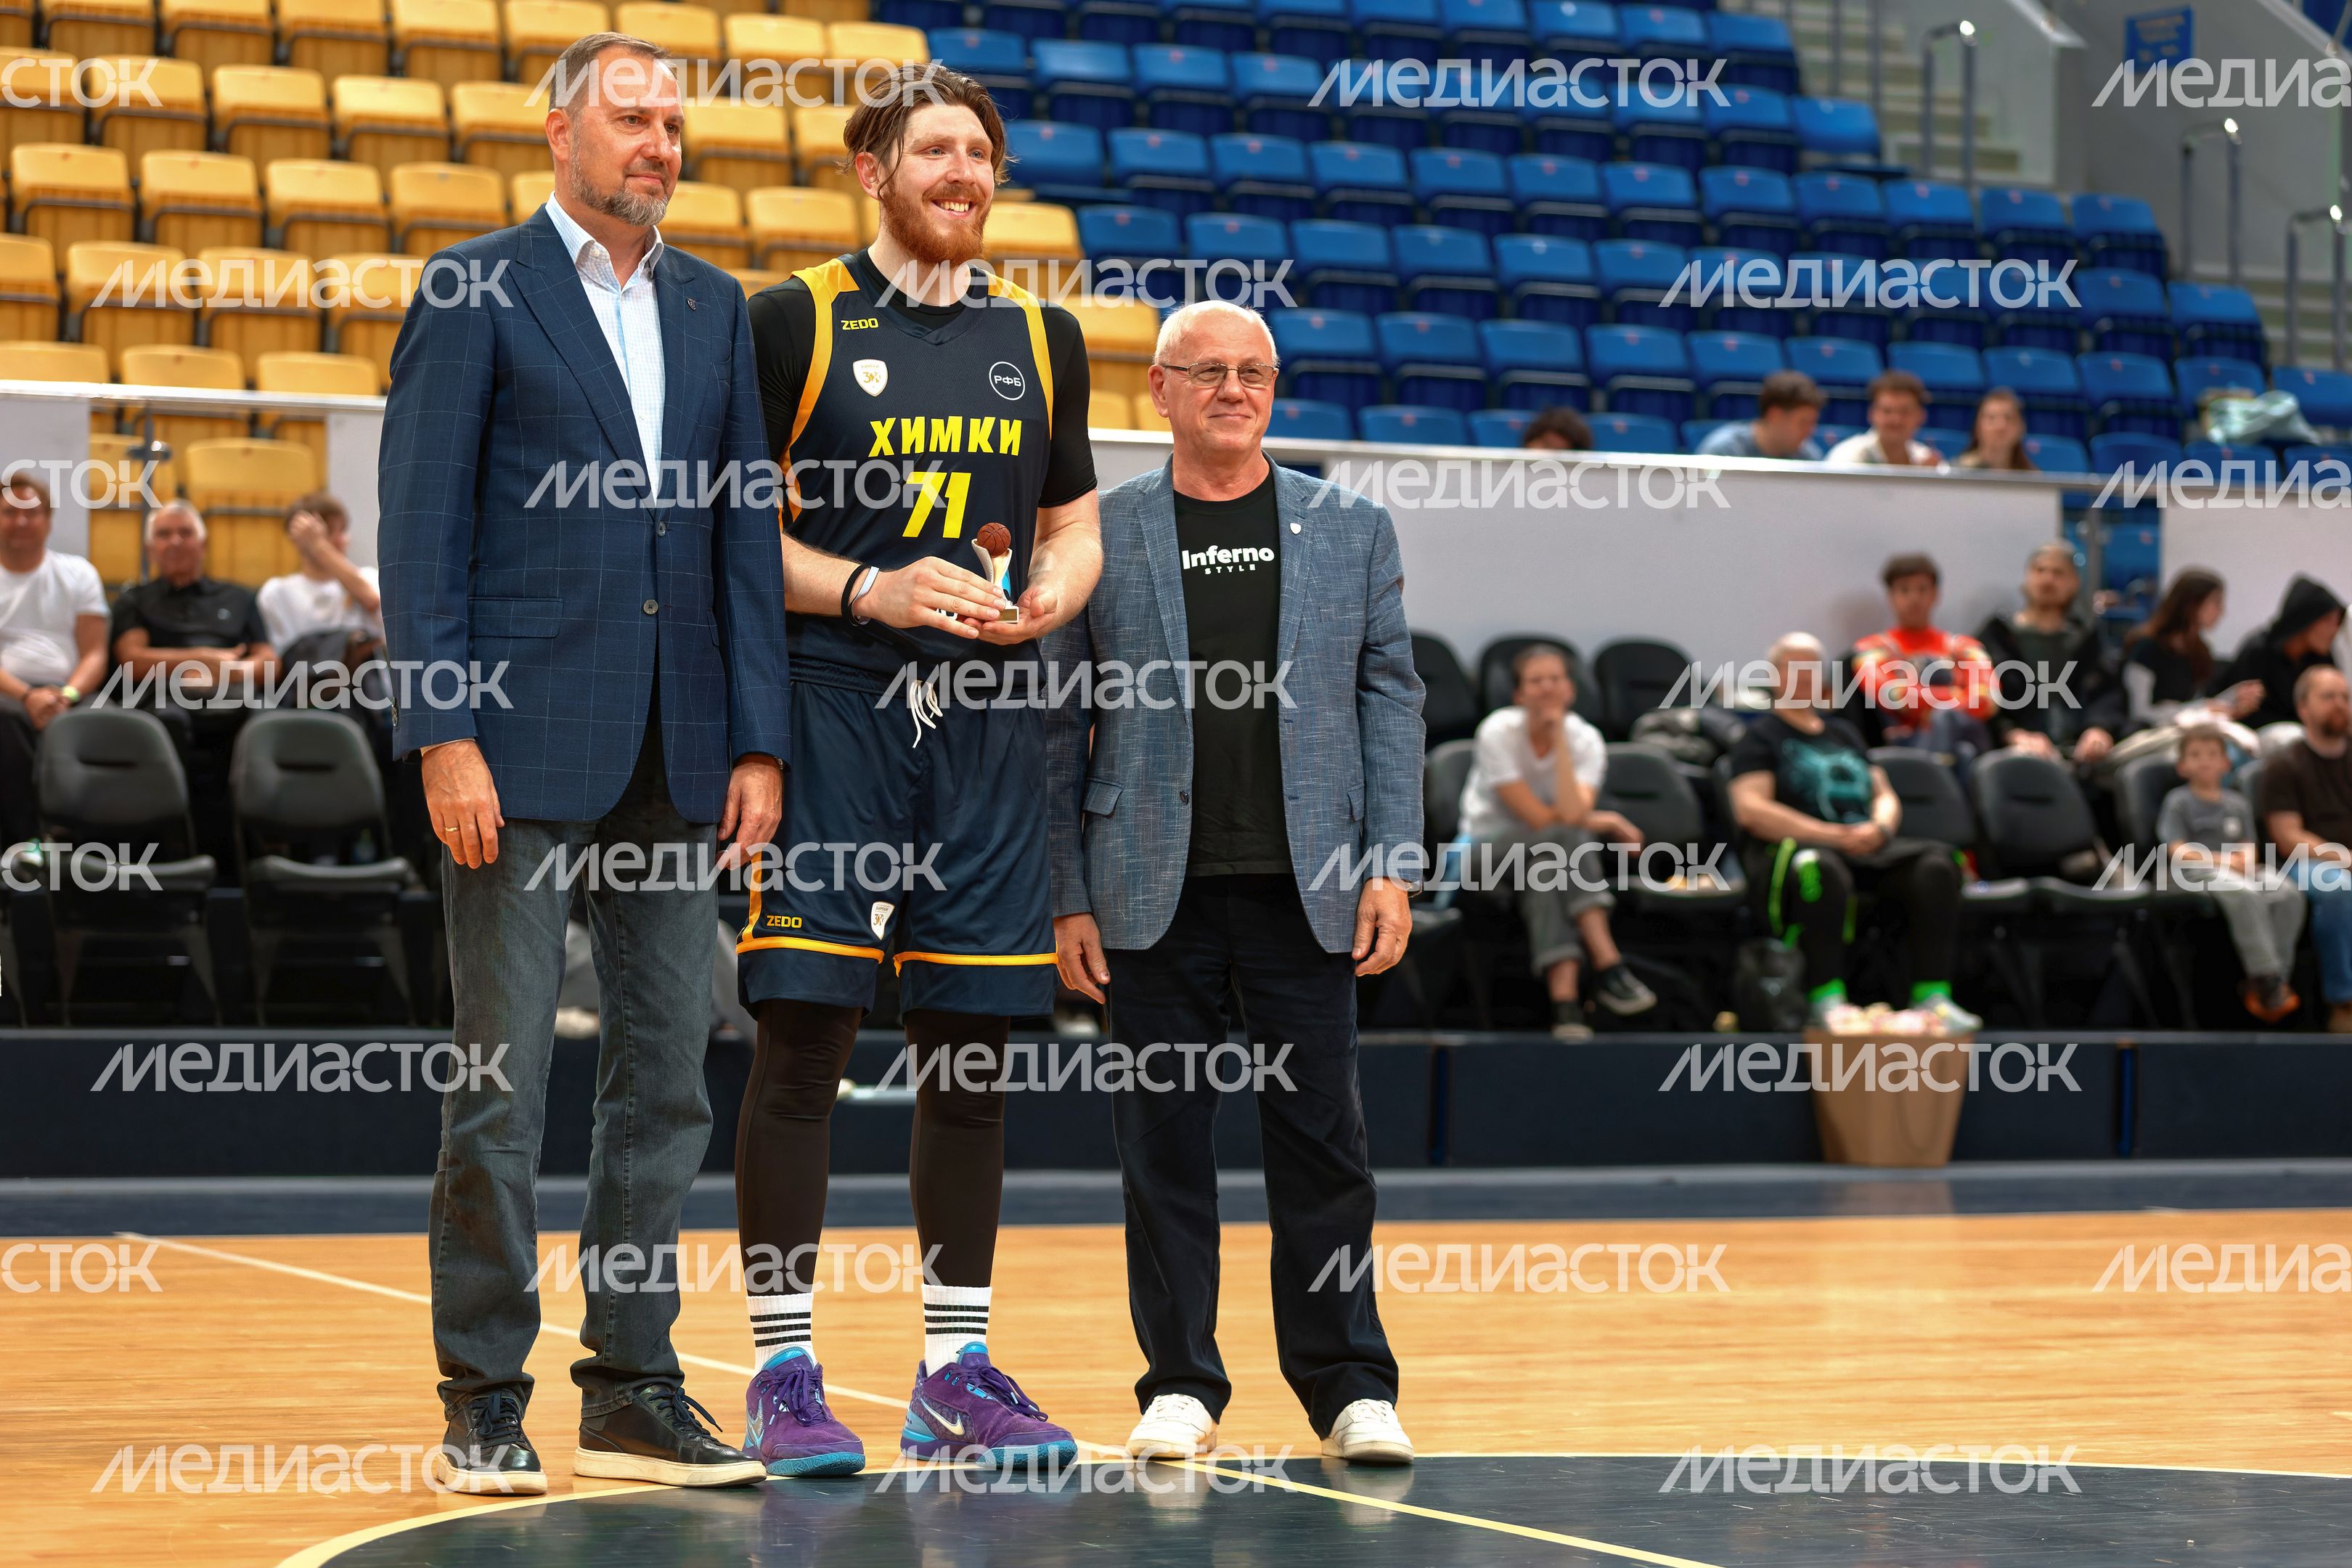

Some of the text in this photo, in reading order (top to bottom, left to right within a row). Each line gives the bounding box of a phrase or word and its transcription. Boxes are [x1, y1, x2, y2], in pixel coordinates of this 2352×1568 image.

[841, 317, 879, 330] ZEDO
[994, 375, 1021, 387] РФБ
[868, 416, 1022, 457] ХИМКИ
[902, 471, 971, 539] 71
[1182, 545, 1275, 570] Inferno
[1204, 564, 1256, 575] STYLE
[767, 915, 802, 928] ZEDO
